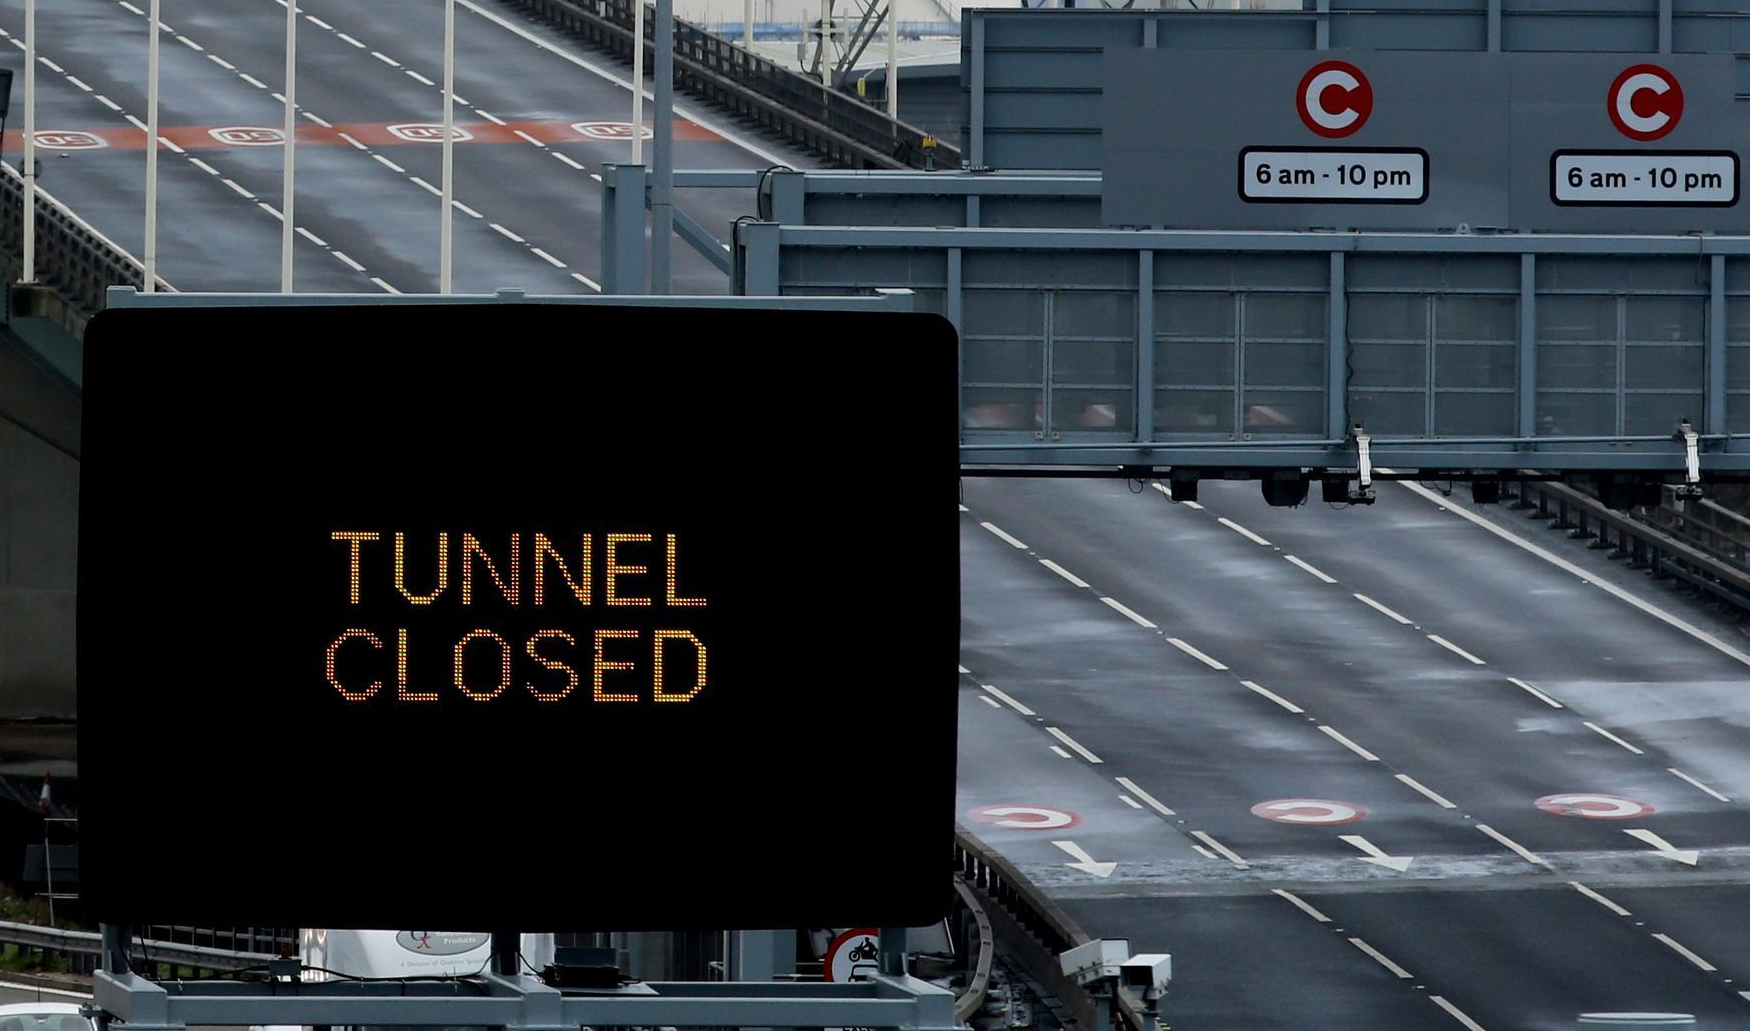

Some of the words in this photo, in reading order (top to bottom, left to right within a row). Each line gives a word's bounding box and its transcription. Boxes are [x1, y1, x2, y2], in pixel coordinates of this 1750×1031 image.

[1306, 71, 1360, 129] C
[1616, 74, 1670, 132] C
[1256, 164, 1272, 185] 6
[1278, 168, 1315, 185] am
[1337, 165, 1367, 185] 10
[1373, 169, 1412, 190] pm
[1567, 167, 1584, 188] 6
[1589, 172, 1627, 188] am
[1648, 168, 1678, 188] 10
[1684, 172, 1723, 193] pm
[330, 531, 708, 607] TUNNEL
[326, 628, 708, 703] CLOSED
